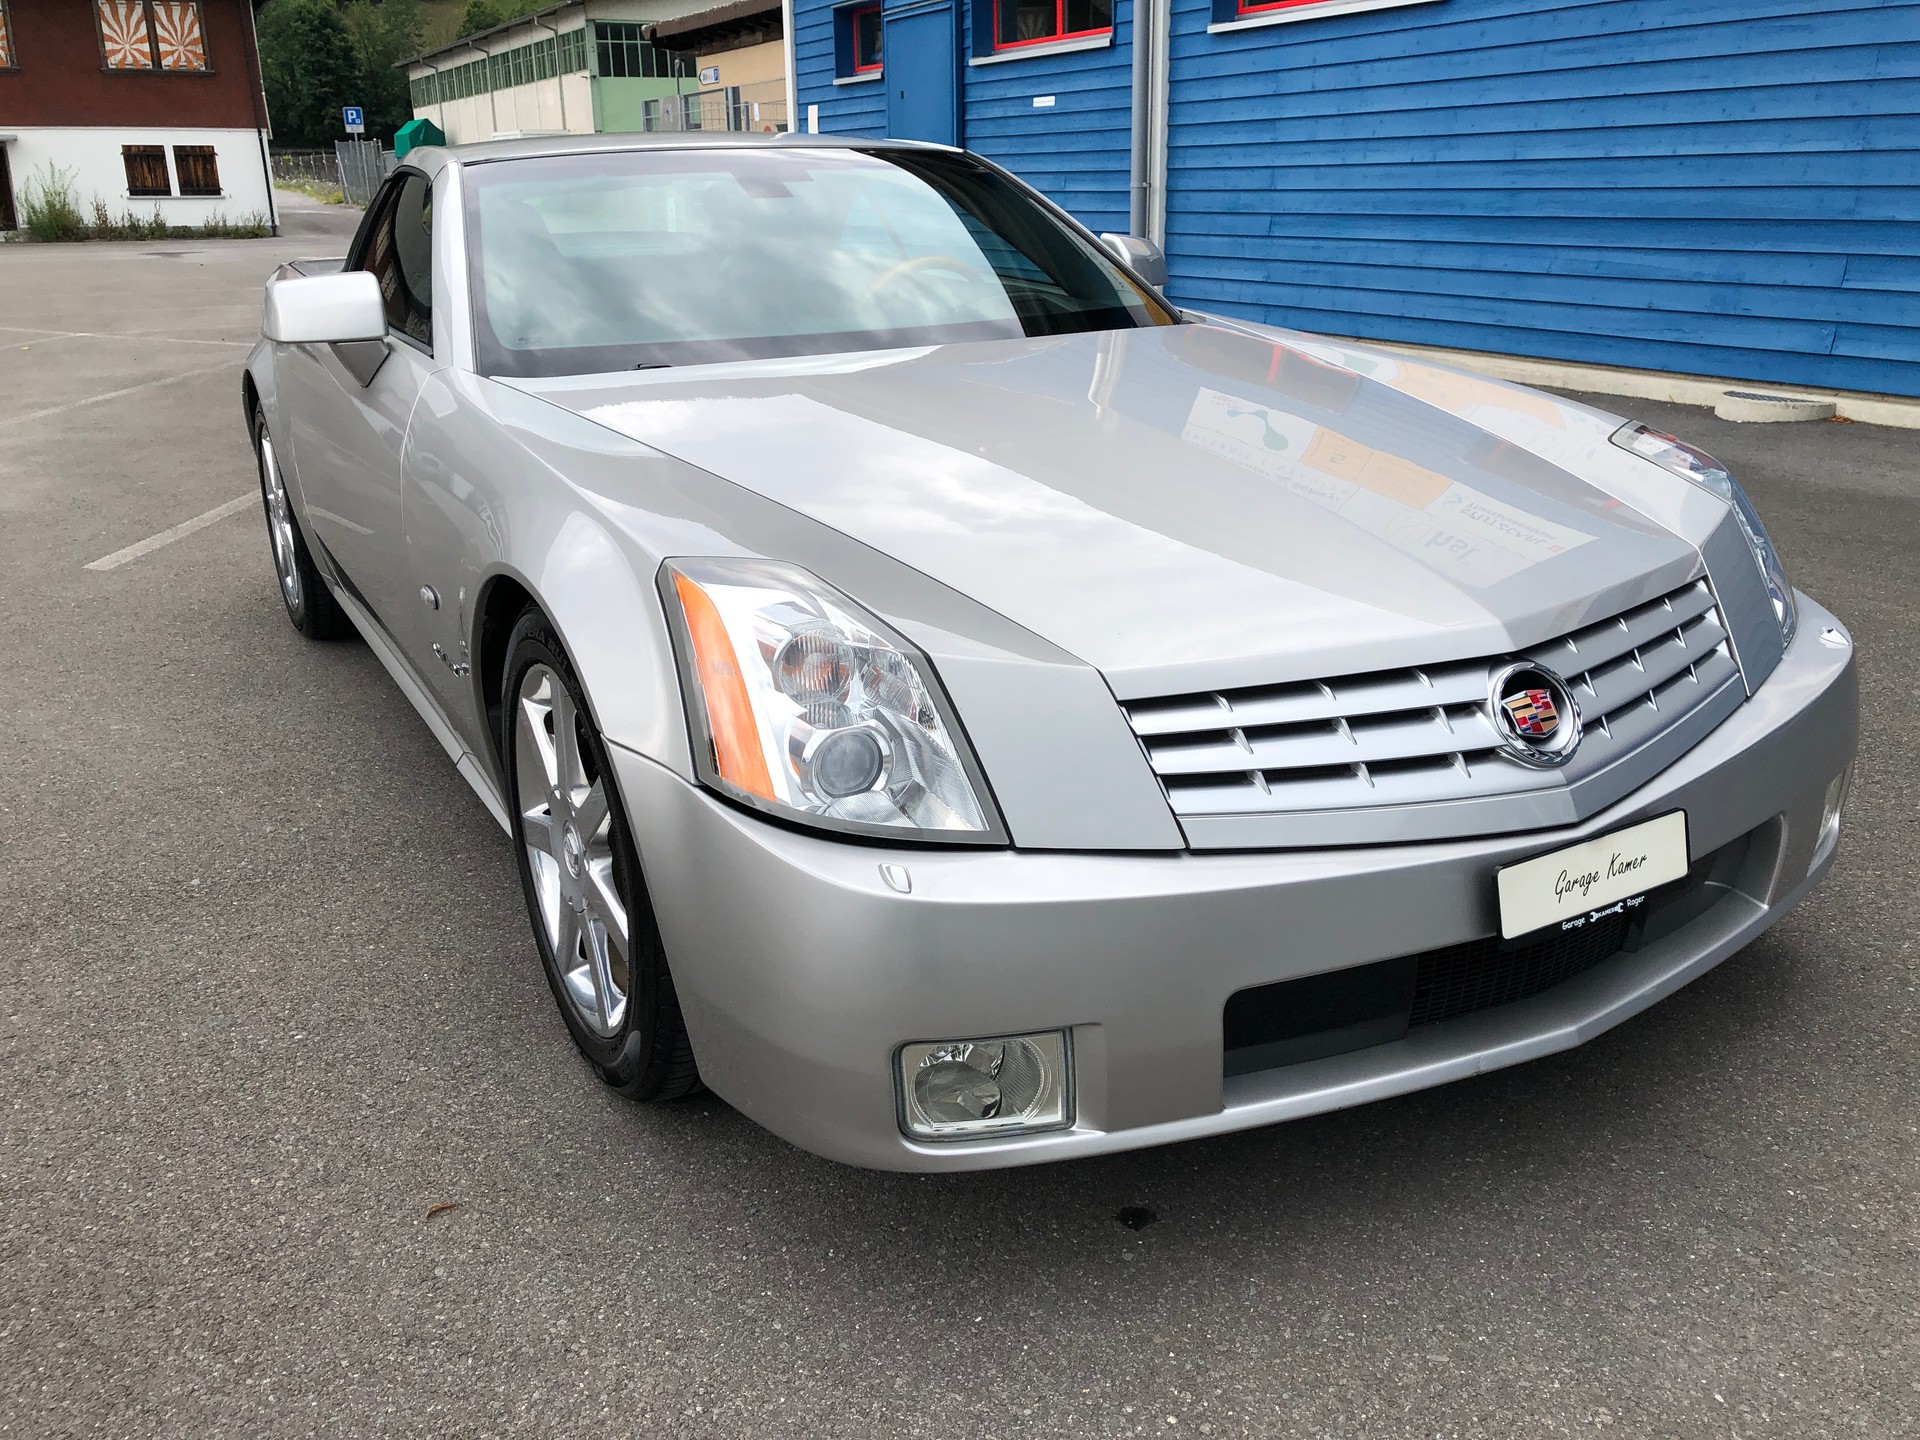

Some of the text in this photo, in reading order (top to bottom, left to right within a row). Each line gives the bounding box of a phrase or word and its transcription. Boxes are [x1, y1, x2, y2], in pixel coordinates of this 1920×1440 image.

[347, 110, 357, 123] P
[1555, 852, 1648, 904] Garage Kamer
[1562, 917, 1586, 930] Garage
[1626, 895, 1645, 907] Roger
